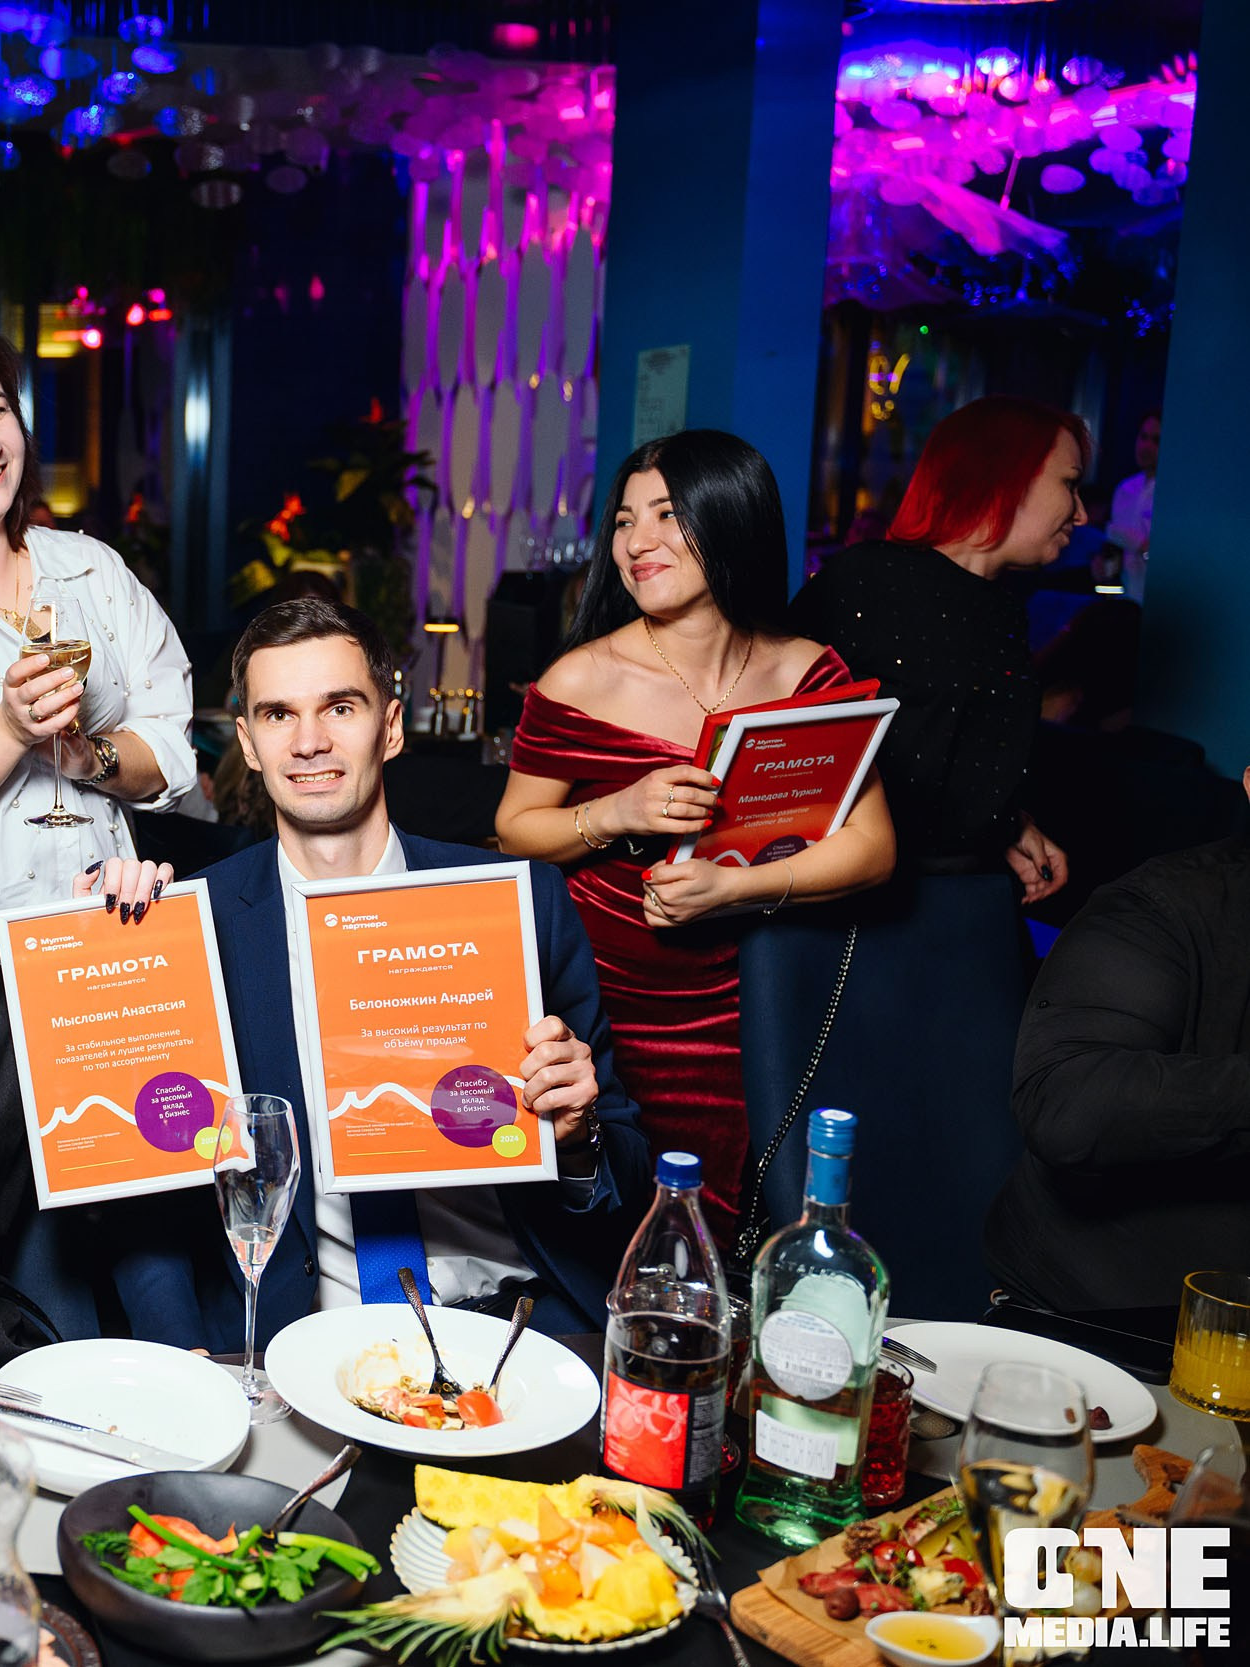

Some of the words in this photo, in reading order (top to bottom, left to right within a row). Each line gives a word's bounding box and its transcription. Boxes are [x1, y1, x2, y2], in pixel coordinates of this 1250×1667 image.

[754, 755, 835, 773] ГРАМОТА
[738, 792, 789, 803] Мамедова
[791, 788, 823, 798] Туркан
[357, 942, 479, 964] ГРАМОТА
[57, 954, 169, 983] ГРАМОТА
[388, 964, 454, 974] награждается
[86, 977, 147, 991] награждается
[349, 995, 437, 1010] Белоножкин
[440, 988, 494, 1005] Андрей
[51, 1010, 119, 1029] Мыслович
[121, 999, 187, 1018] Анастасия
[361, 1028, 373, 1038] За
[375, 1024, 420, 1037] высокий
[422, 1022, 472, 1034] результат
[474, 1021, 488, 1030] по
[65, 1044, 76, 1053] За
[77, 1037, 126, 1051] стабильное
[127, 1028, 181, 1043] выполнение
[383, 1037, 424, 1049] объёму
[426, 1035, 467, 1046] продаж
[55, 1049, 109, 1065] показателей
[110, 1049, 117, 1057] и
[146, 1037, 194, 1051] результаты
[82, 1064, 94, 1072] по
[95, 1061, 111, 1071] топ
[111, 1052, 171, 1068] ассортименту
[155, 1084, 186, 1095] Спасибо
[454, 1078, 488, 1088] Спасибо
[160, 1091, 193, 1103] весомый
[459, 1086, 495, 1096] весомый
[162, 1102, 185, 1111] вклад
[164, 1109, 191, 1118] бизнес
